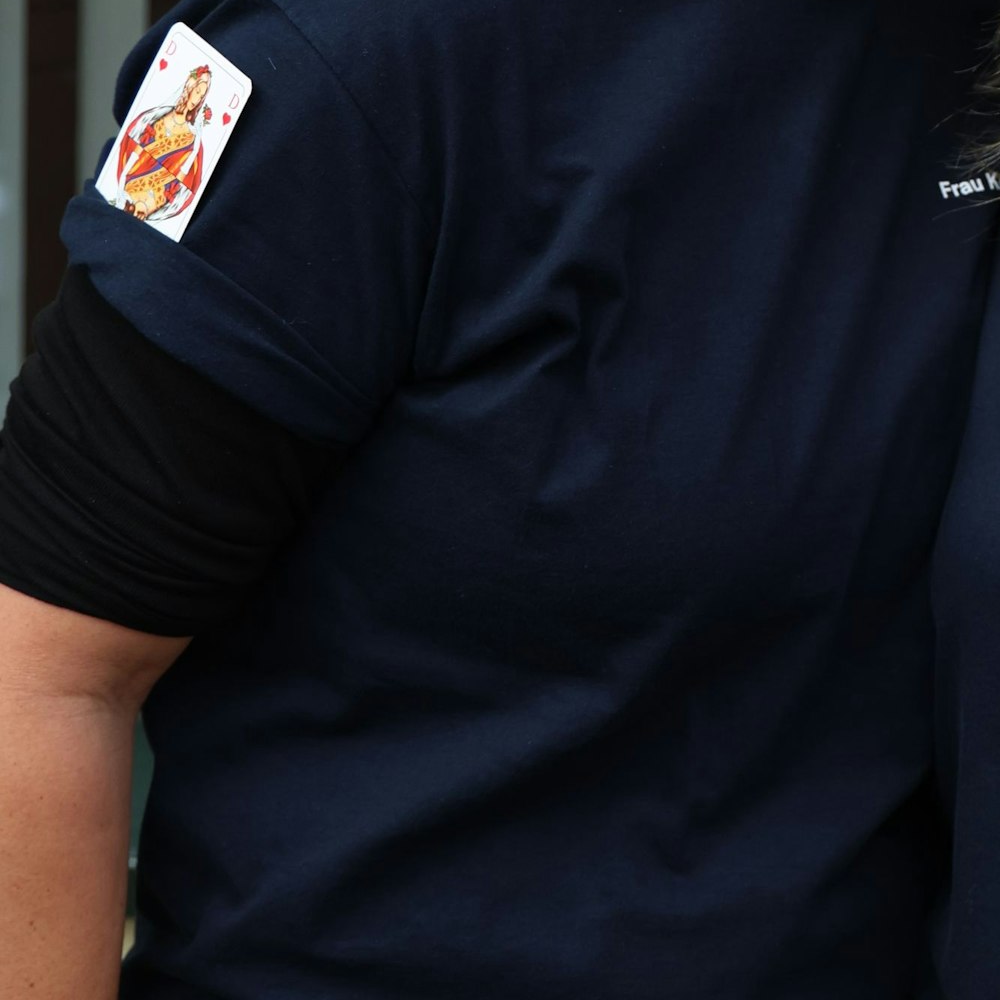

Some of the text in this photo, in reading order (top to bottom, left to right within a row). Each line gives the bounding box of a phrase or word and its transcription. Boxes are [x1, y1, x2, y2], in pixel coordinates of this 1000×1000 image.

[165, 40, 177, 56] D
[228, 93, 240, 109] D
[938, 177, 985, 199] Frau
